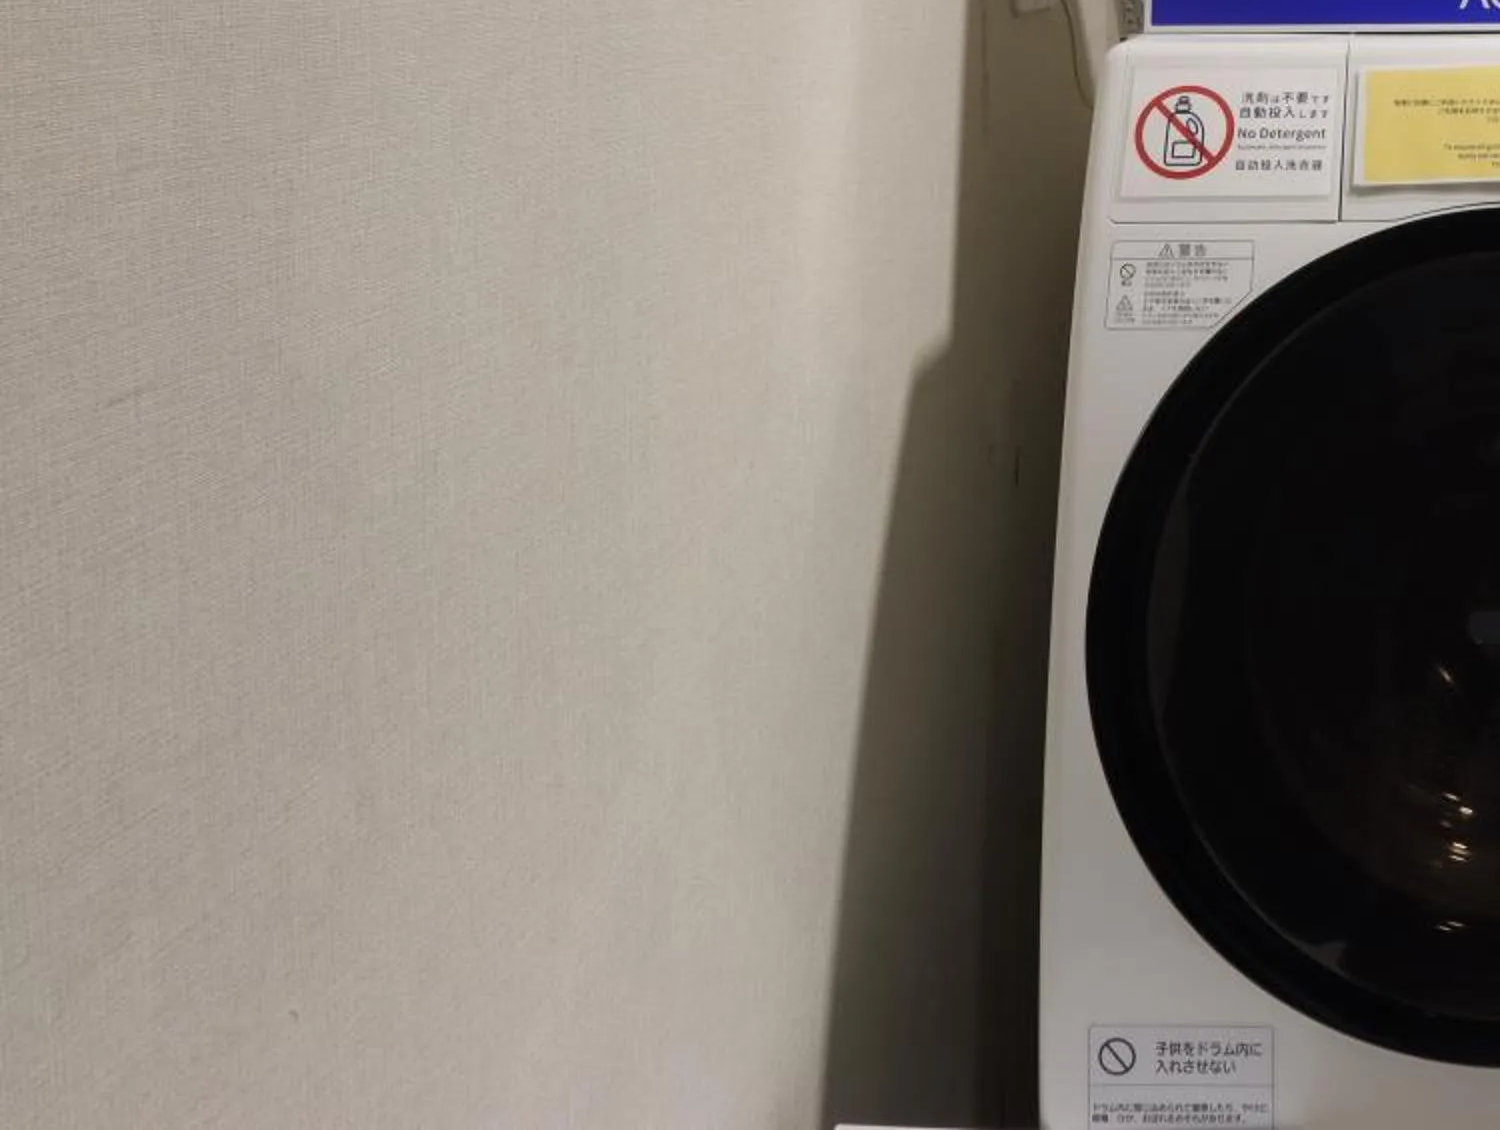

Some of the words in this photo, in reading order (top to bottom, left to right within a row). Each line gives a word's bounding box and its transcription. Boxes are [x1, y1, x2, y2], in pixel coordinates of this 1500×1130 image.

[1242, 91, 1331, 106] 洗剤は不要です
[1240, 106, 1329, 119] 自動投入します
[1237, 127, 1256, 139] No
[1259, 127, 1327, 142] Detergent
[1155, 1040, 1263, 1057] 子供をドラム内に
[1155, 1059, 1238, 1075] 入れさせない
